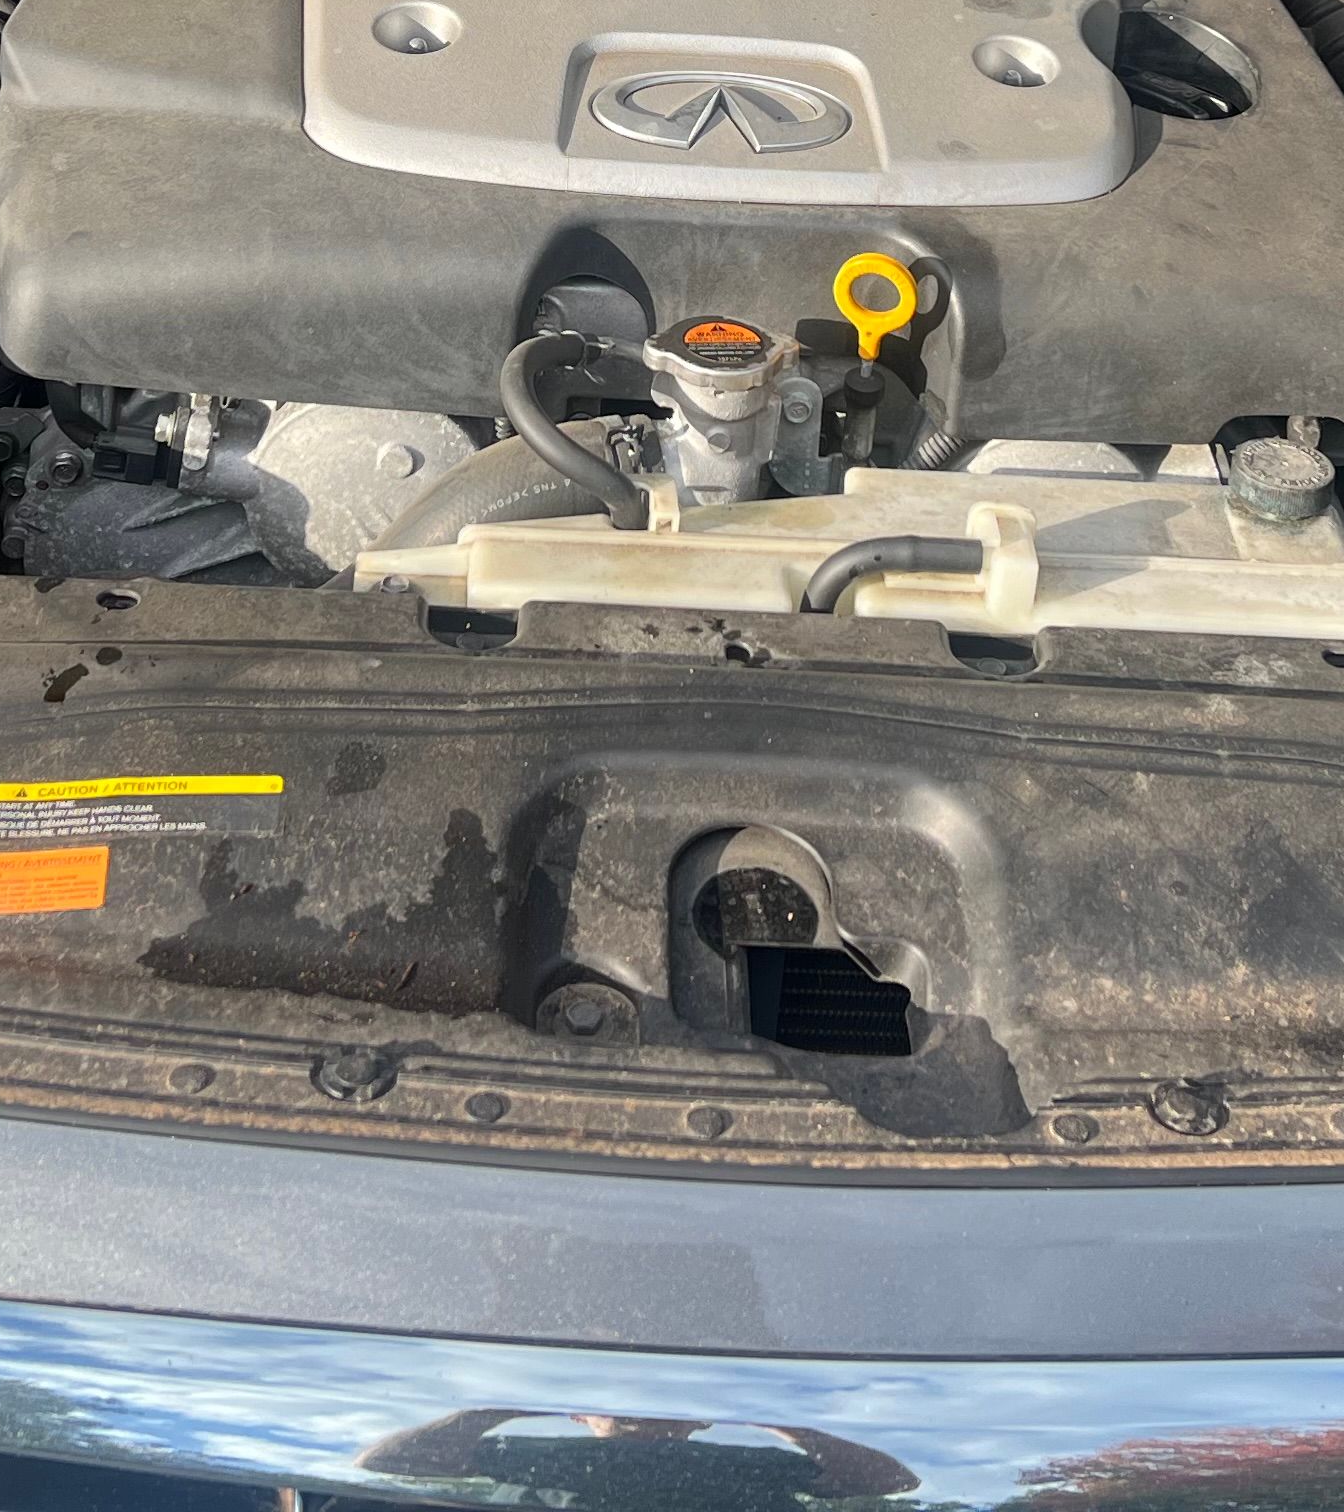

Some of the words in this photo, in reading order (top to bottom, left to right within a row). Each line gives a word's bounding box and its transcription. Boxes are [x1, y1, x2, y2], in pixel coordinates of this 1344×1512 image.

[533, 481, 557, 494] TNS
[38, 786, 98, 797] CAUTION
[112, 781, 188, 792] ATTENTION
[23, 802, 35, 810] AT
[26, 820, 39, 829] DE
[57, 827, 70, 836] NE
[70, 826, 89, 835] PAS
[90, 825, 103, 833] EN
[159, 822, 176, 831] LES
